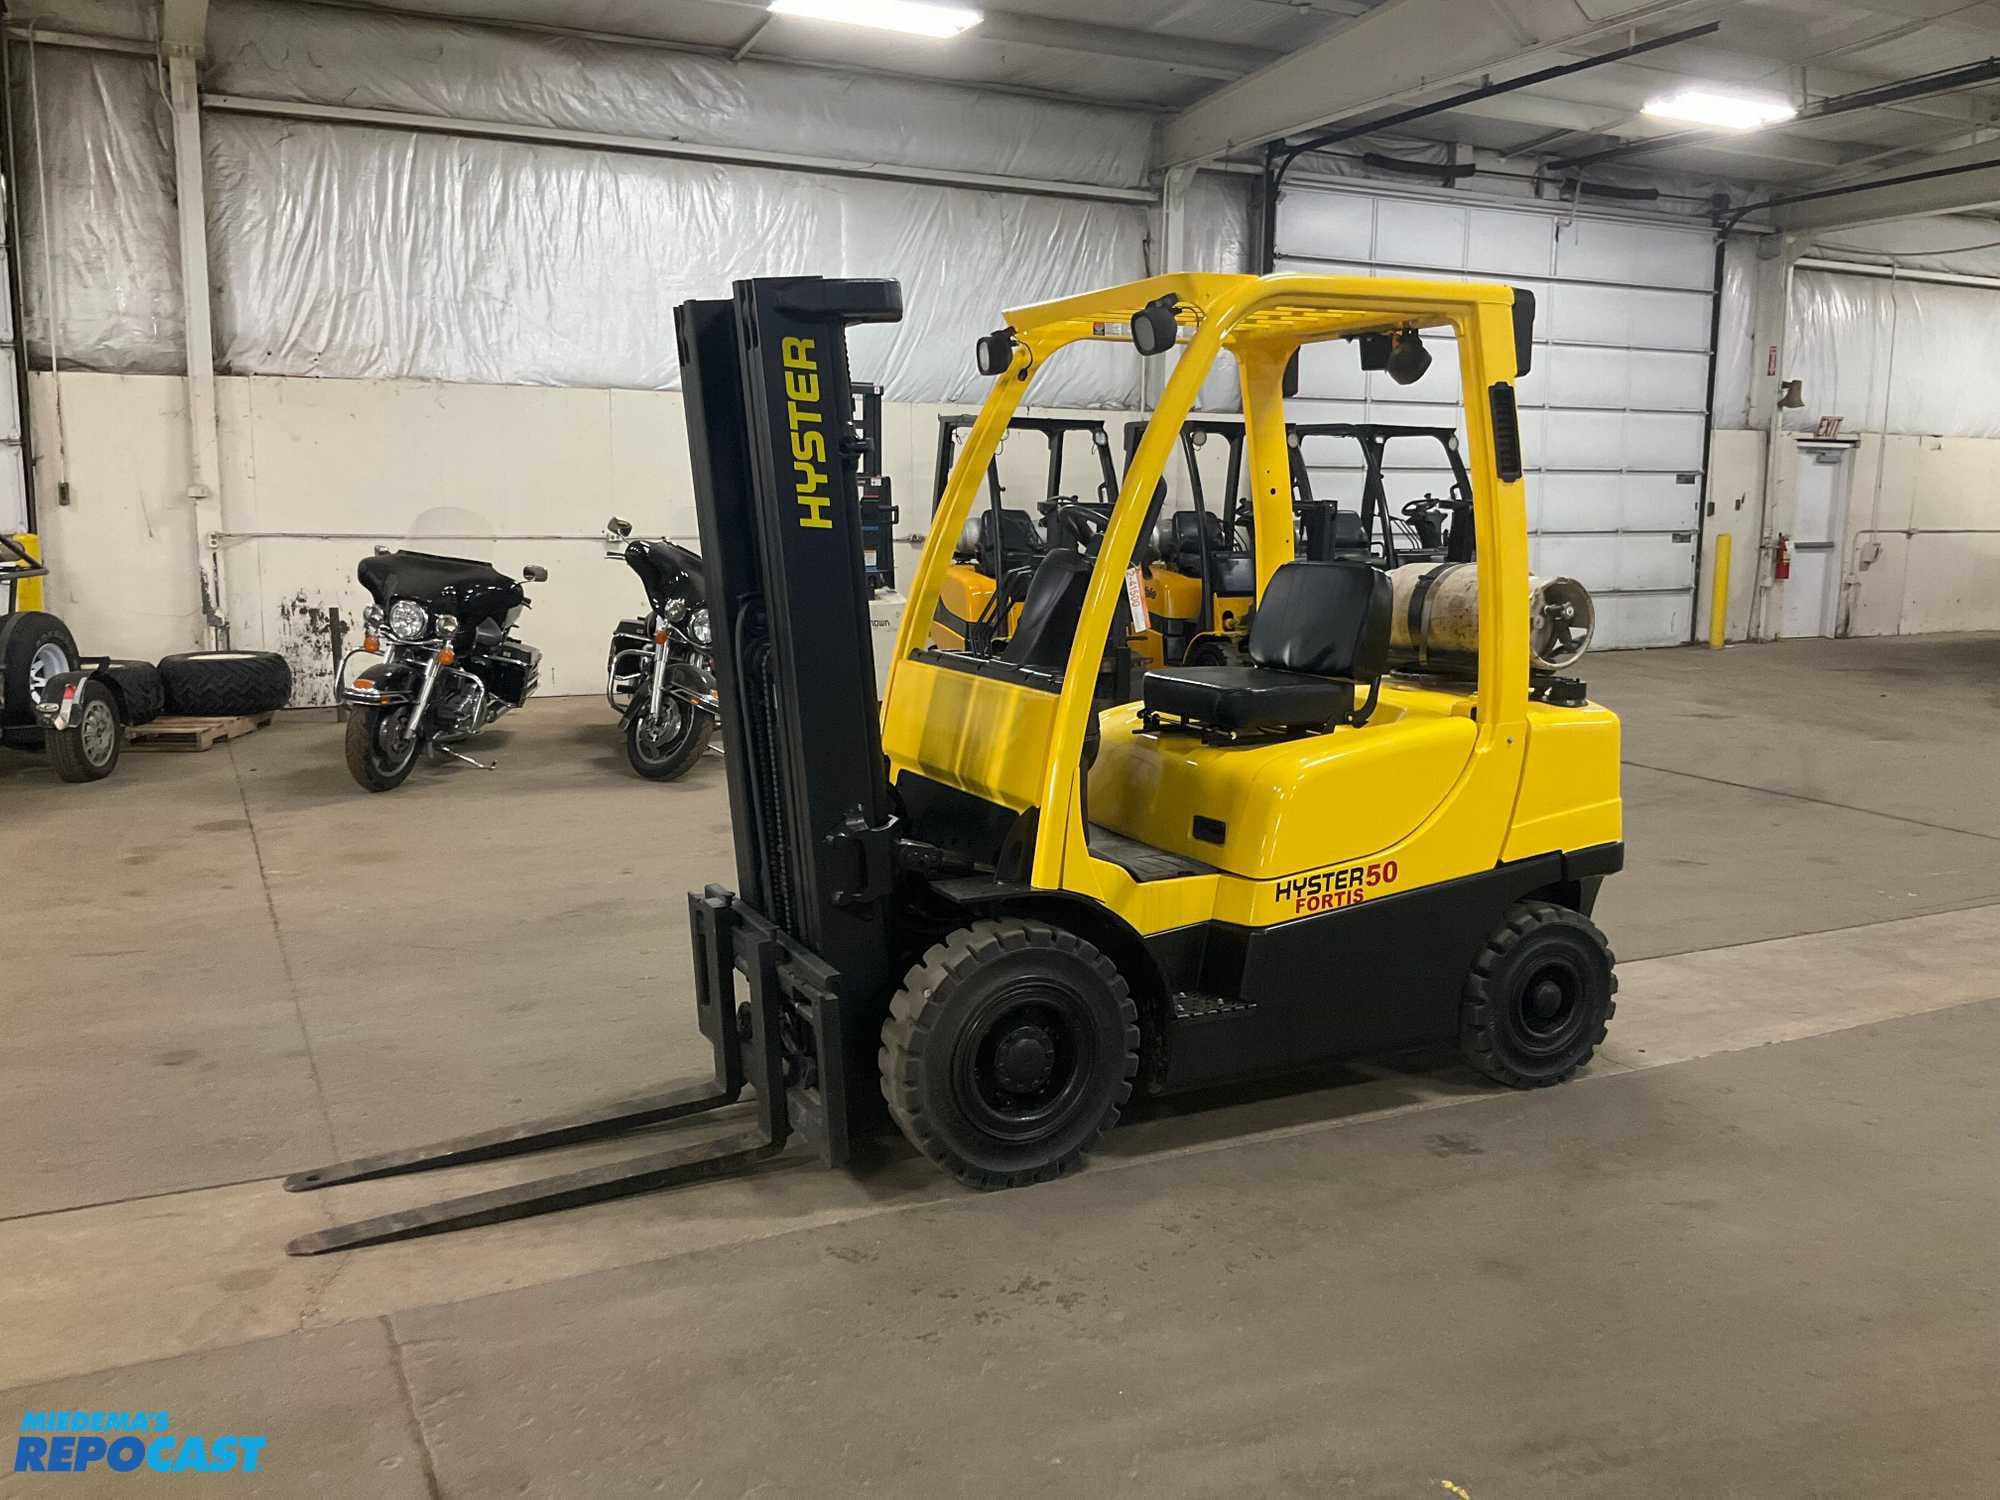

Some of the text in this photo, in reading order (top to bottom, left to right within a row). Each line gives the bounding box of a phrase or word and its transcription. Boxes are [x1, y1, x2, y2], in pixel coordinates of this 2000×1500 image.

[782, 336, 833, 529] HYSTER
[1817, 418, 1843, 437] EXIT
[1275, 860, 1398, 903] HYSTER 50
[1294, 886, 1363, 914] FORTIS
